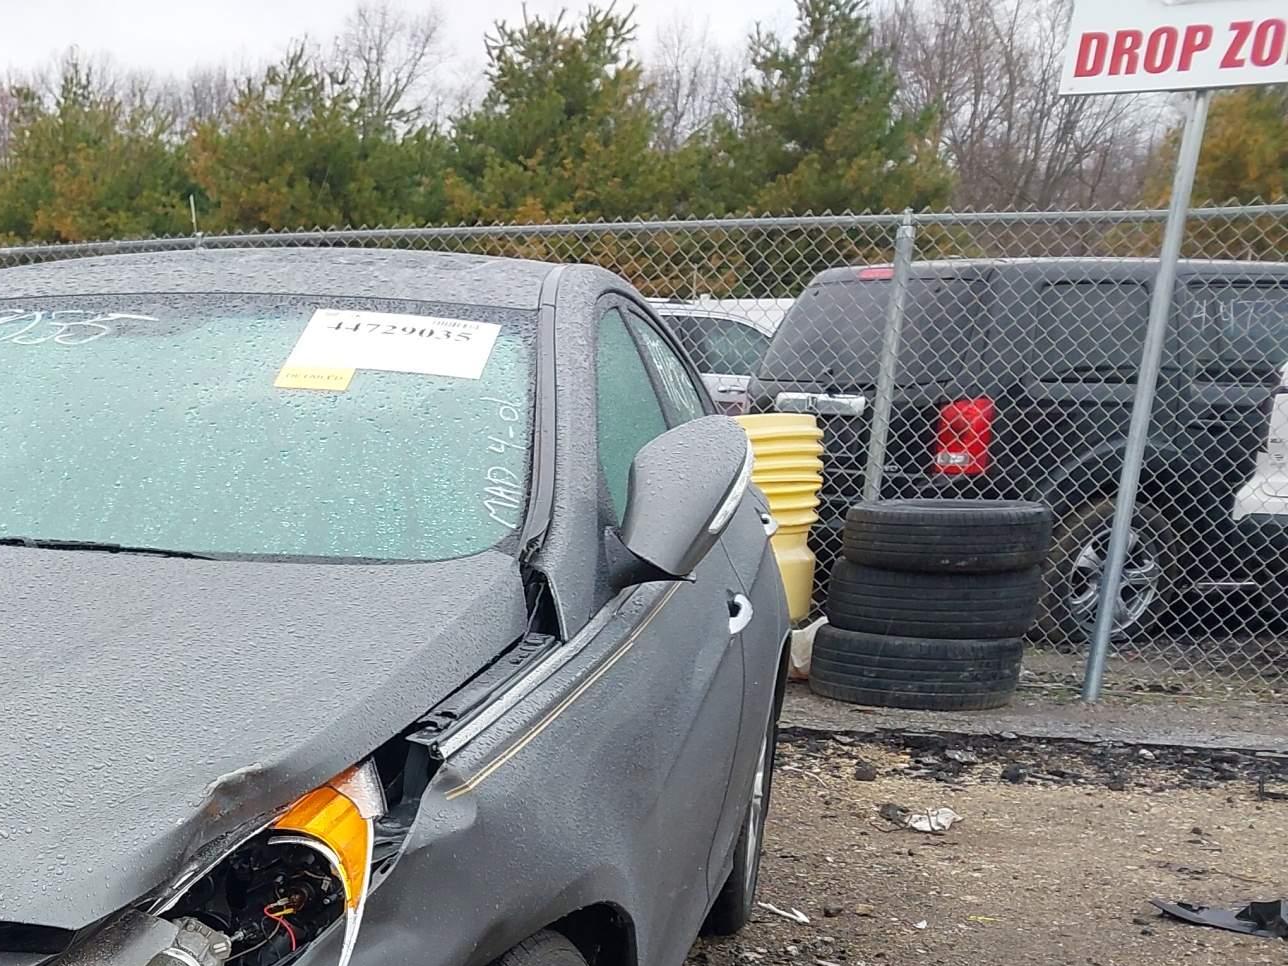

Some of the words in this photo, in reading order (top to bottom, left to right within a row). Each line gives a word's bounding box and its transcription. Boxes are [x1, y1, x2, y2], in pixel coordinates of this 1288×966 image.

[1073, 24, 1214, 78] DROP
[1219, 18, 1288, 69] ZO
[327, 321, 473, 342] 44729035
